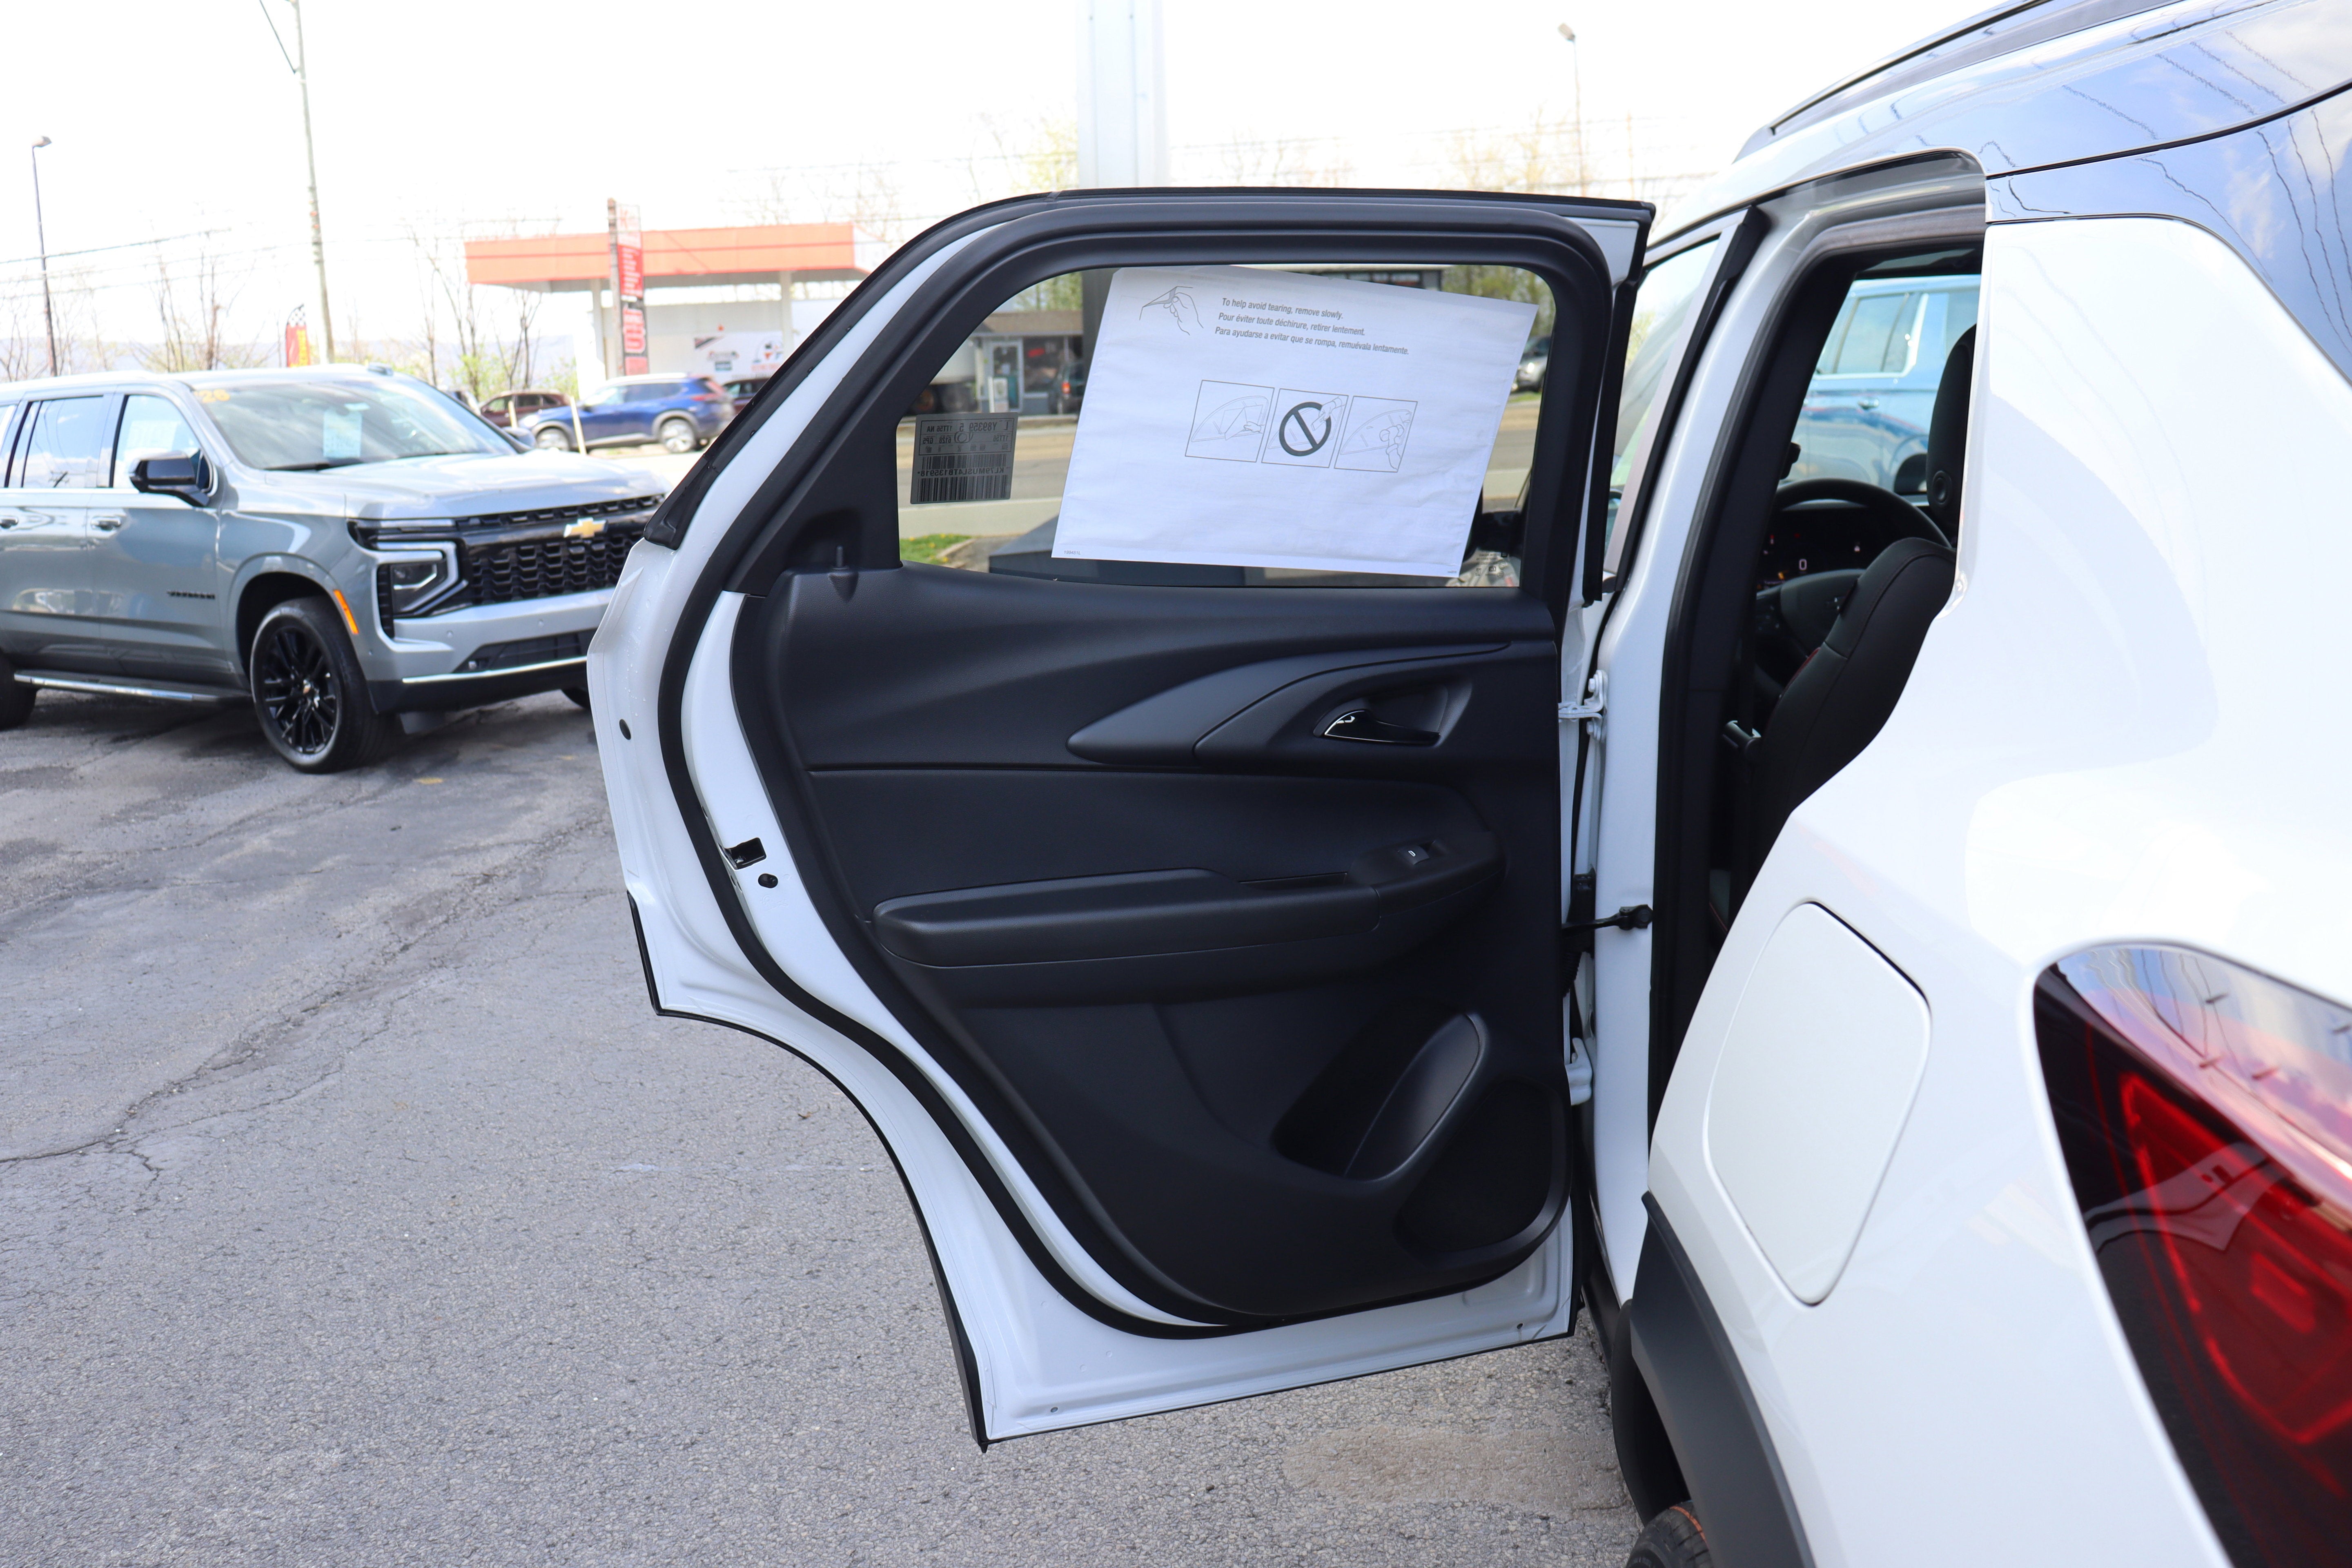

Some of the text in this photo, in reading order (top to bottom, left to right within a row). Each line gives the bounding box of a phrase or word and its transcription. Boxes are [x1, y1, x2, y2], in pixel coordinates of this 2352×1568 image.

[1232, 299, 1246, 309] help
[1268, 304, 1293, 314] tearing,
[1295, 307, 1319, 316] remove
[1321, 310, 1343, 320] slowly.
[1218, 312, 1365, 336] Pour éviter toute déchirure, retirer lentement.
[1215, 327, 1230, 335] Para
[1232, 329, 1263, 339] ayudarse
[1314, 339, 1337, 348] rompa,
[1339, 341, 1371, 350] remuévala
[1372, 344, 1409, 354] lentamente.
